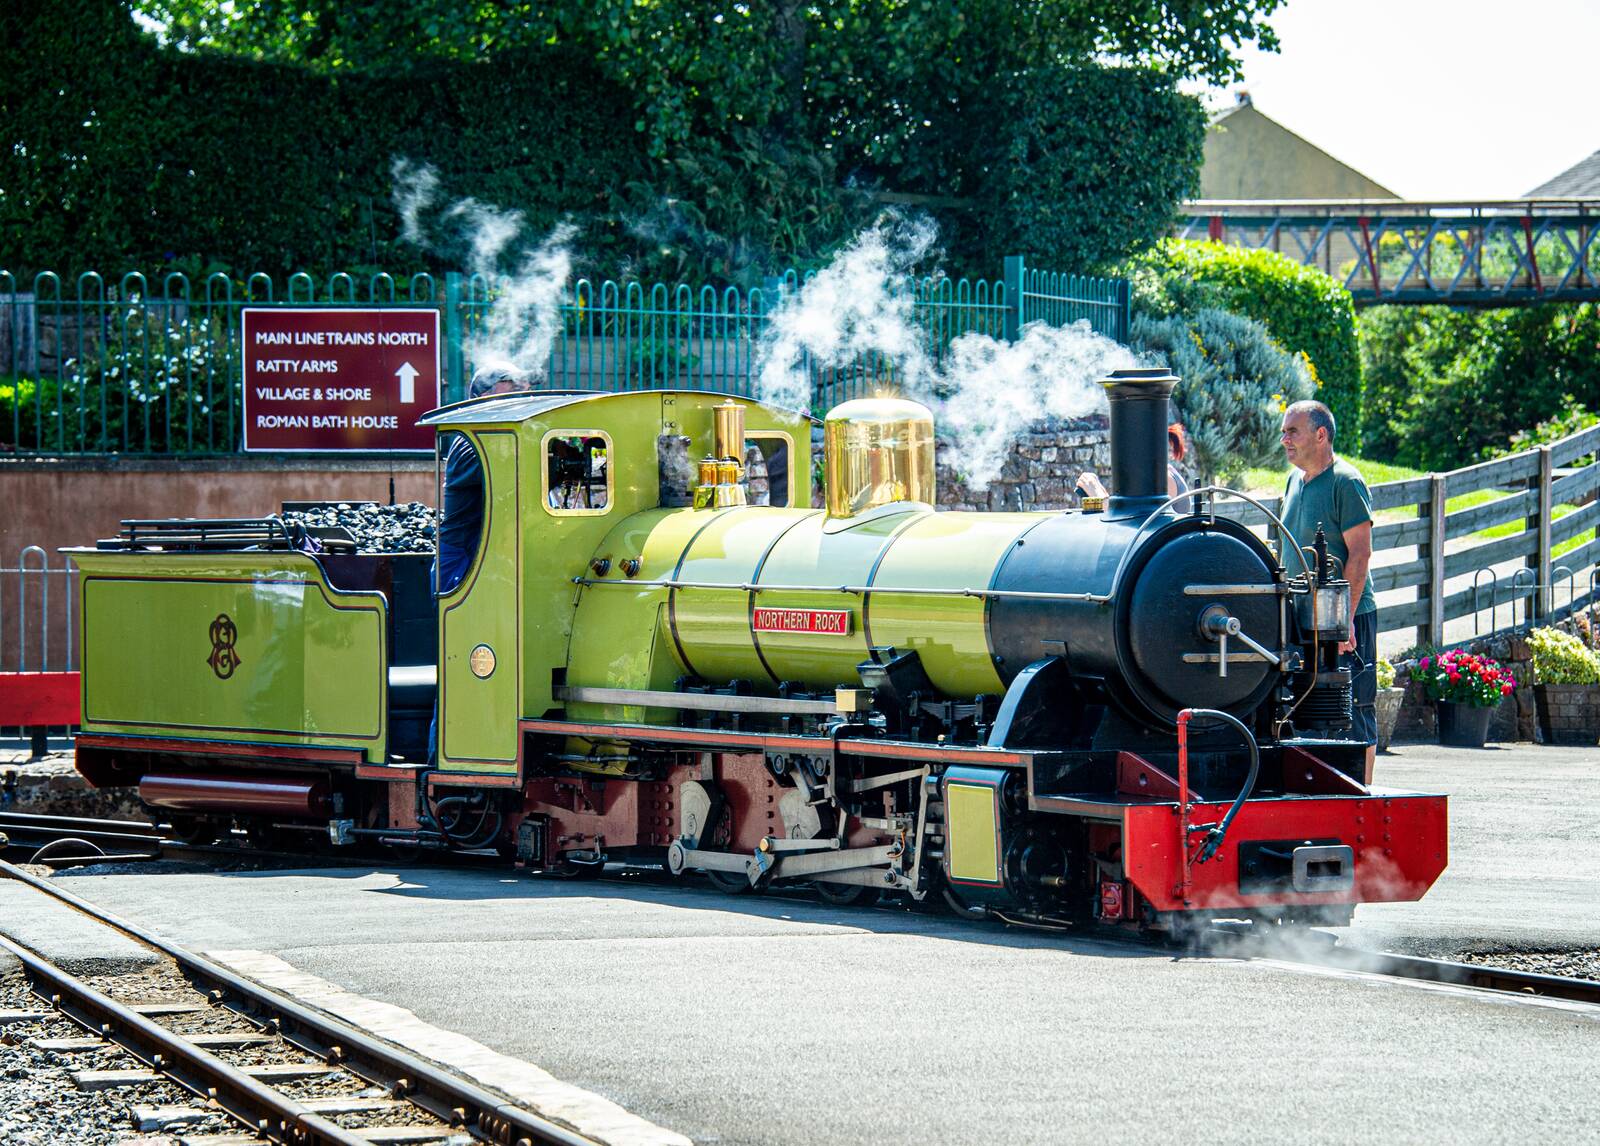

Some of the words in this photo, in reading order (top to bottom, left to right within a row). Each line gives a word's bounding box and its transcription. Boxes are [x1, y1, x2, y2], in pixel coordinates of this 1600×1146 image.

[255, 332, 292, 345] MAIN
[295, 332, 325, 345] LINE
[325, 332, 375, 345] TRAINS
[377, 332, 428, 346] NORTH
[256, 360, 300, 373] RATTY
[301, 360, 338, 373] ARMS
[256, 388, 310, 400] VILLAGE
[313, 388, 323, 400] &
[326, 388, 371, 400] SHORE
[257, 415, 309, 428] ROMAN
[312, 415, 348, 428] BATH
[351, 415, 398, 429] HOUSE
[758, 611, 810, 630] NORTHERN
[815, 614, 841, 631] ROCK
